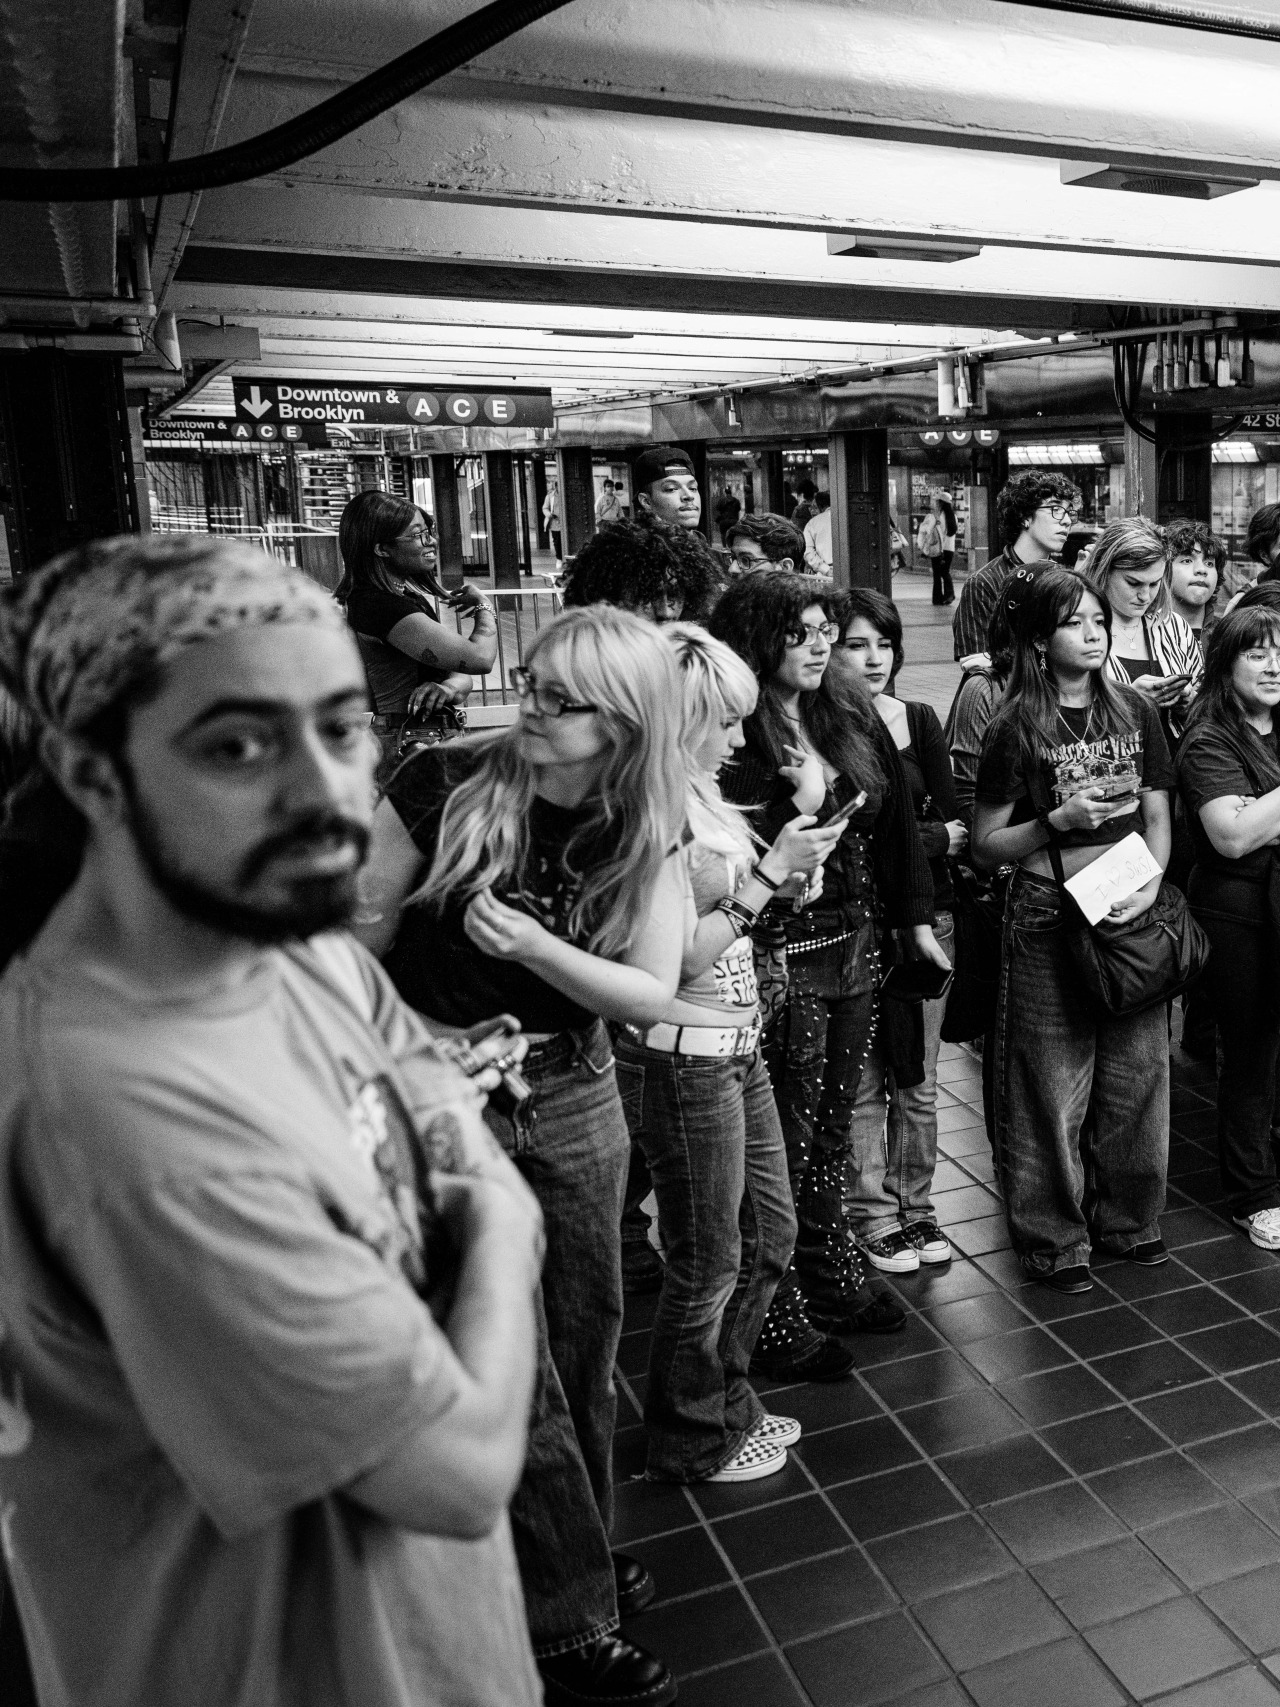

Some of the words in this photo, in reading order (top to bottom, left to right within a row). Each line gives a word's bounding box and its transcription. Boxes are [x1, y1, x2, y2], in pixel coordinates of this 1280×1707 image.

[277, 386, 381, 403] Downtown
[386, 389, 400, 404] &
[278, 403, 364, 422] Brooklyn
[414, 398, 433, 417] A
[453, 399, 471, 418] C
[492, 400, 508, 418] E
[150, 420, 214, 430] Downtown
[218, 420, 227, 430] &
[1242, 413, 1260, 427] 42
[150, 430, 205, 440] Brooklyn
[236, 426, 248, 437] A
[260, 426, 273, 438] C
[286, 427, 297, 438] E
[331, 438, 350, 448] Exit
